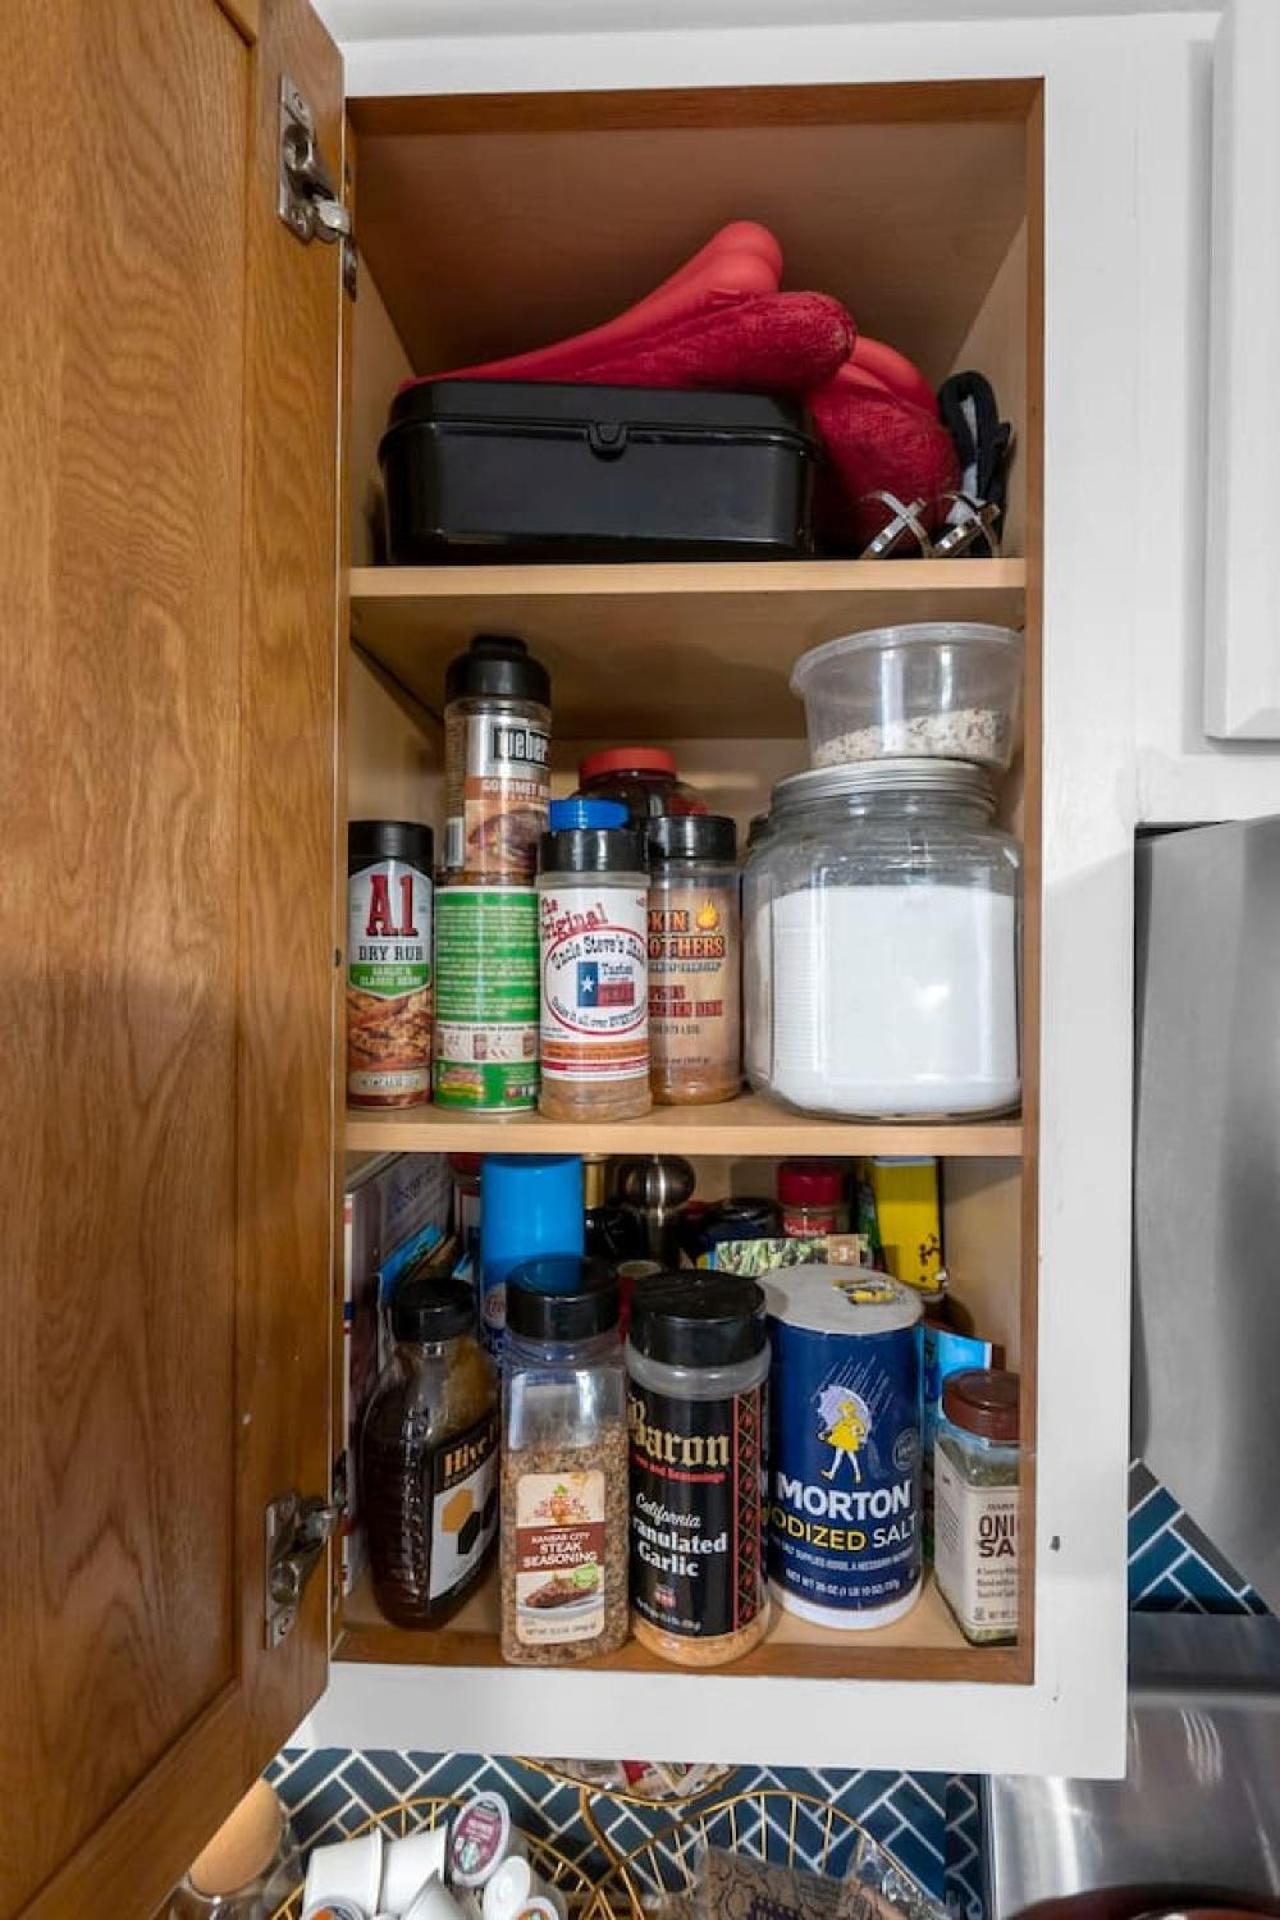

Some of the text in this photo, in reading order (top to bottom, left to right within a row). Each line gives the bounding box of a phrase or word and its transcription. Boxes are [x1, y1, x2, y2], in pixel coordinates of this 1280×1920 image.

[359, 945, 422, 960] DRY RUB
[584, 935, 624, 954] Steve's
[648, 935, 725, 959] OTHERS
[626, 1391, 730, 1468] Baron
[776, 1471, 912, 1522] MORTON
[635, 1492, 702, 1527] California
[531, 1531, 591, 1545] KANSAS CITY
[632, 1516, 728, 1555] ranulated
[766, 1506, 866, 1551] ODIZED
[873, 1510, 918, 1548] SALT
[979, 1514, 1015, 1541] ONI
[523, 1552, 598, 1568] SEASONING
[538, 1541, 582, 1556] STEAK
[638, 1539, 699, 1577] Garlic
[978, 1538, 1015, 1558] SA
